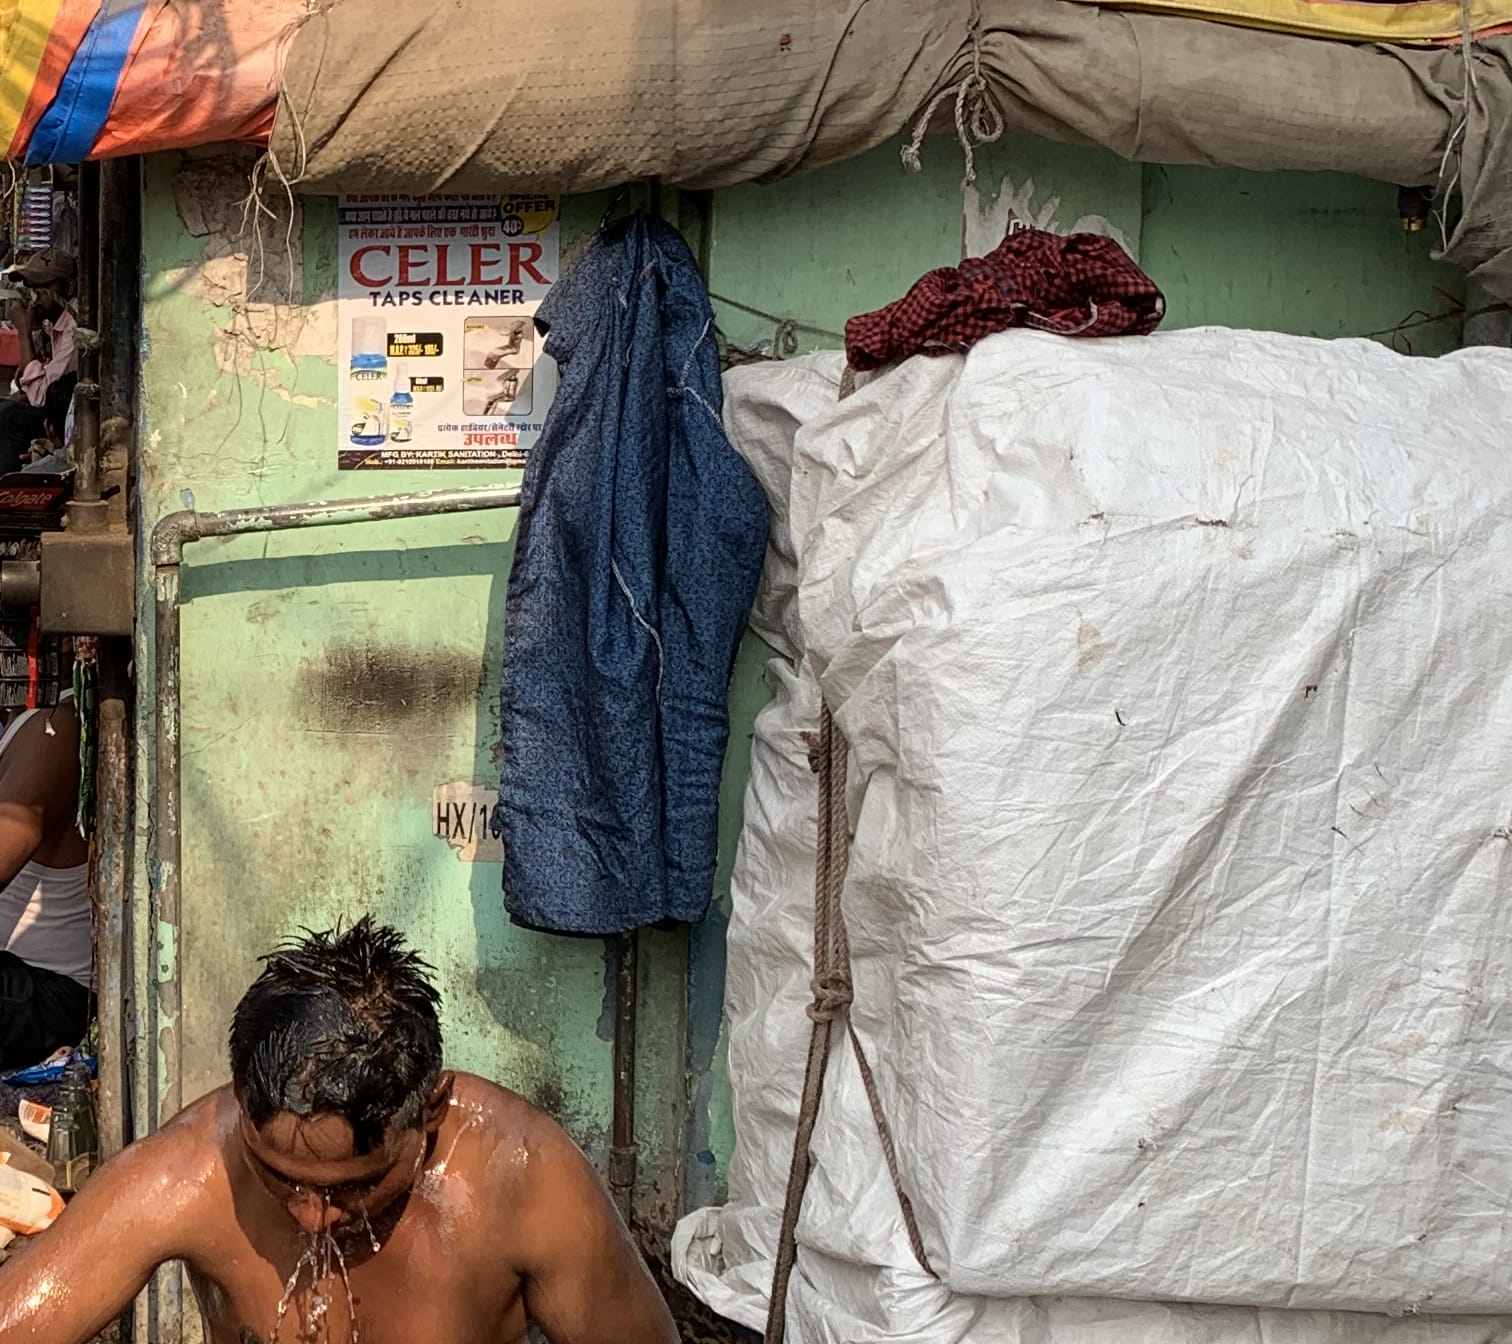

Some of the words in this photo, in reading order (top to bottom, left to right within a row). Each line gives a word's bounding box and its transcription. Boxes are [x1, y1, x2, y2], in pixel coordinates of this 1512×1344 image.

[503, 199, 556, 214] OFFER
[349, 242, 553, 288] CELER
[369, 291, 423, 308] TAPS
[428, 288, 525, 306] CLEANER
